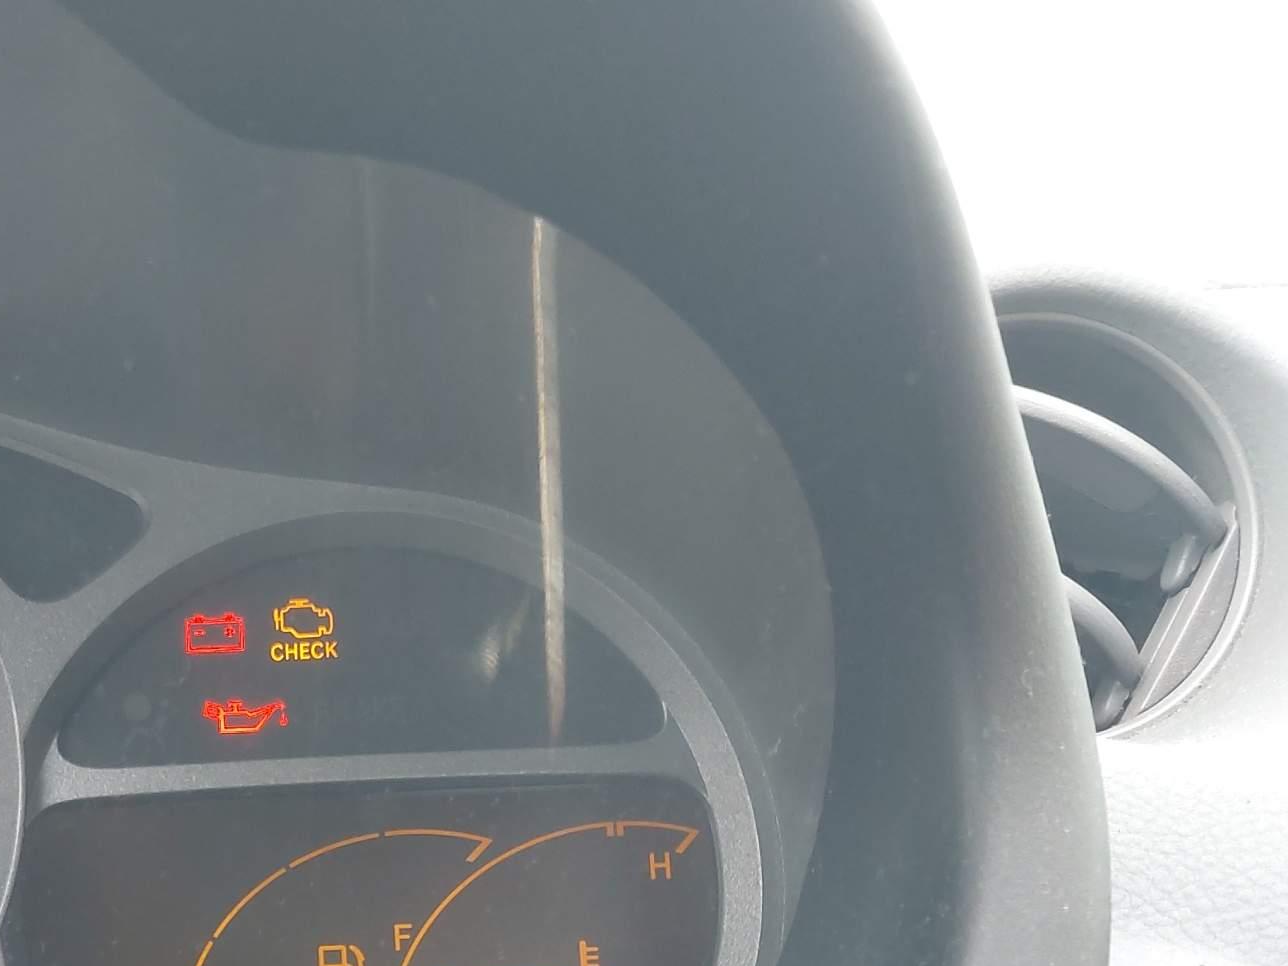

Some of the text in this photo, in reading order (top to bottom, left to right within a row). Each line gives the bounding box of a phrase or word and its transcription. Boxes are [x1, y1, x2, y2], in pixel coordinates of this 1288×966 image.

[269, 641, 338, 662] CHECK
[647, 853, 672, 880] H
[394, 924, 413, 951] F
